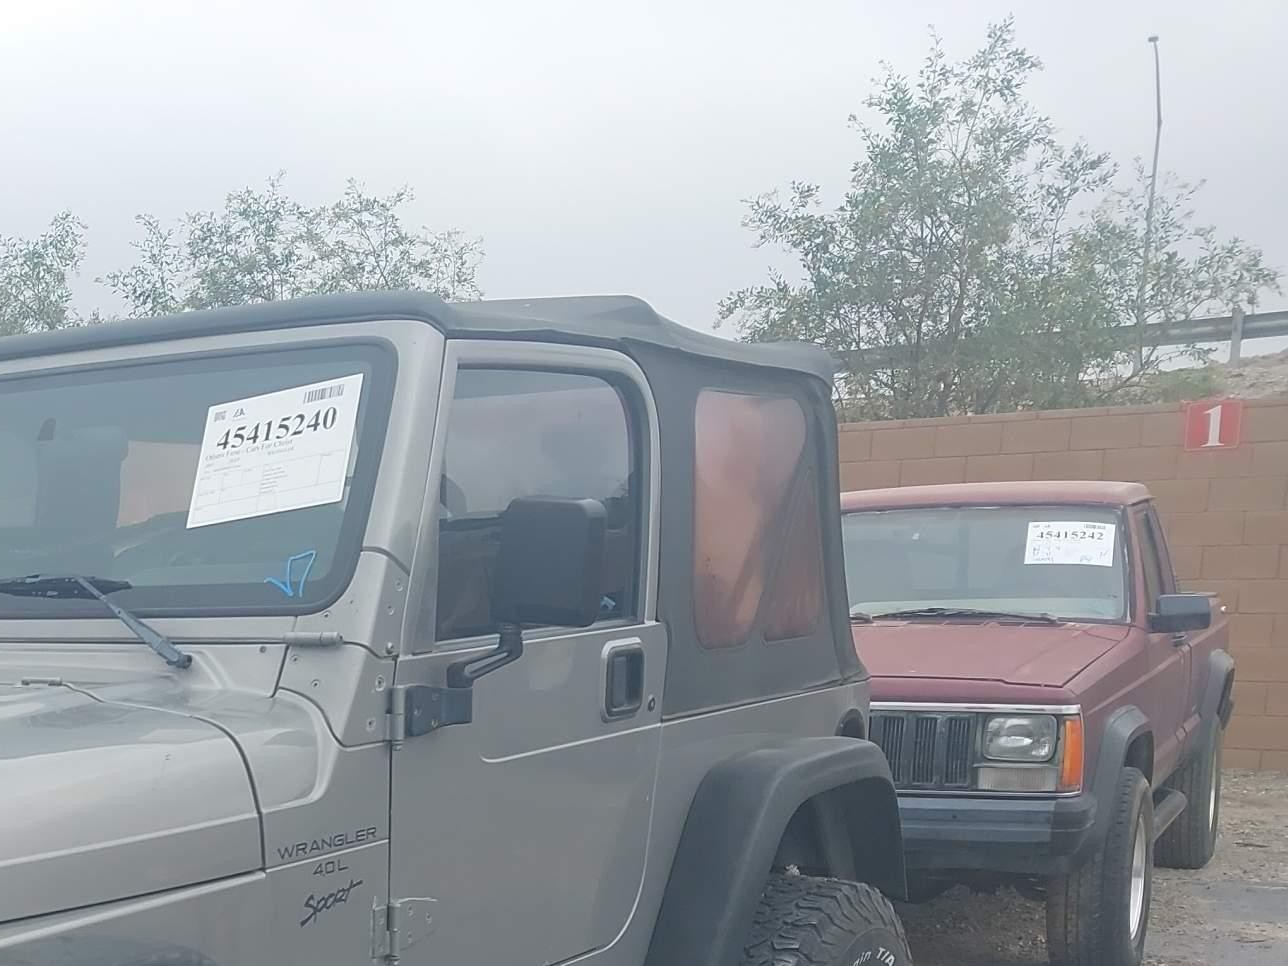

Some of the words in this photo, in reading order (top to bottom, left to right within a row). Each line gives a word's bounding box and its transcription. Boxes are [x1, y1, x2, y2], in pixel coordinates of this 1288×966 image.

[216, 406, 338, 451] 45415240
[1201, 404, 1224, 448] 1
[1036, 530, 1105, 542] 45415242
[277, 826, 377, 860] WRANGLER
[300, 879, 364, 927] Sport
